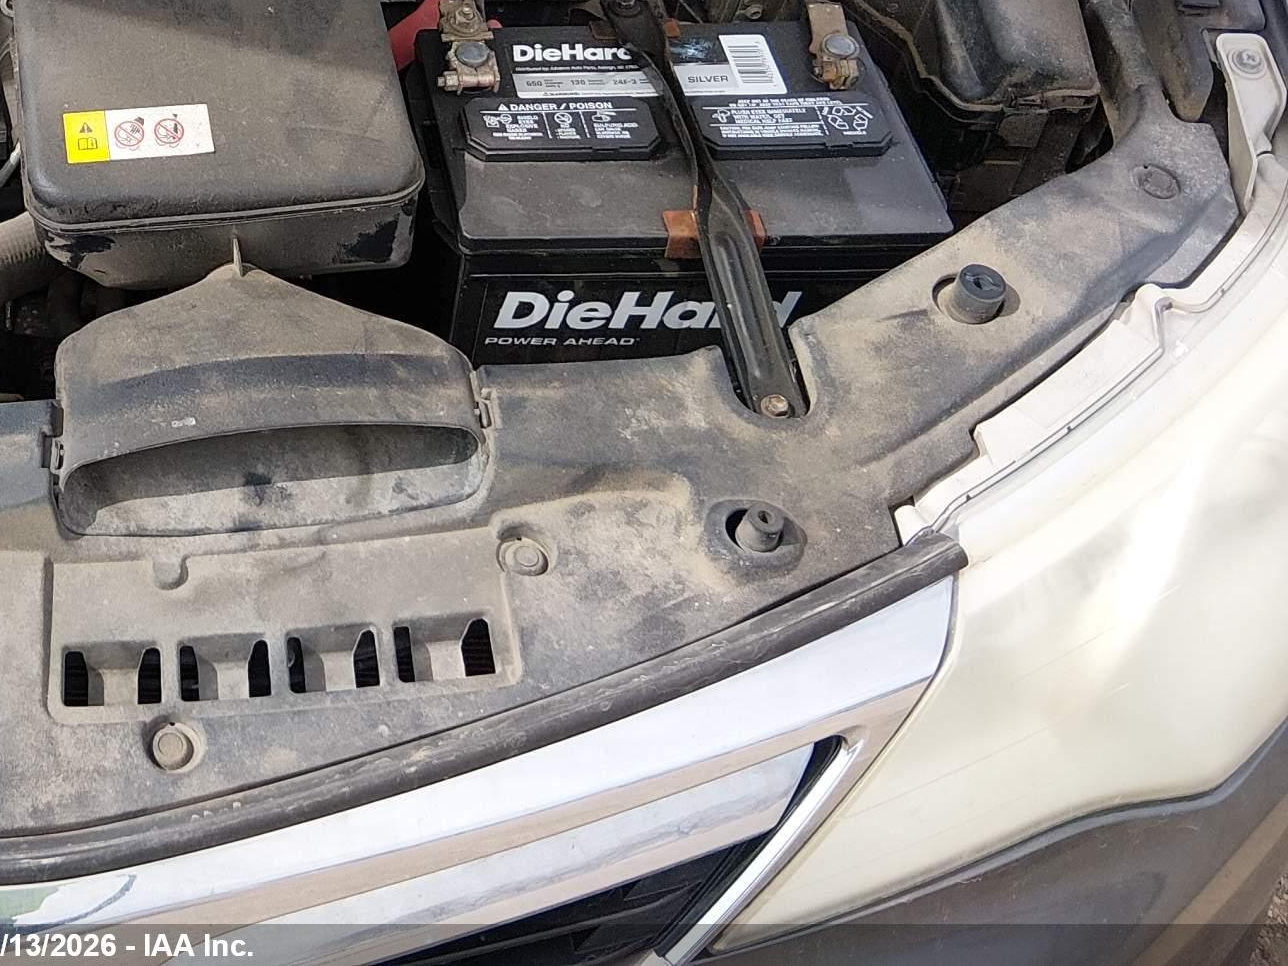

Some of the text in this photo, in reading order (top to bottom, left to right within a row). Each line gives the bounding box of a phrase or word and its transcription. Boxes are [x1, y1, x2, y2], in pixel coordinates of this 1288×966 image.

[687, 75, 729, 84] SILVER
[510, 103, 557, 111] DANGER
[493, 290, 803, 329] DieHad
[484, 337, 636, 345] POWER AHEAD
